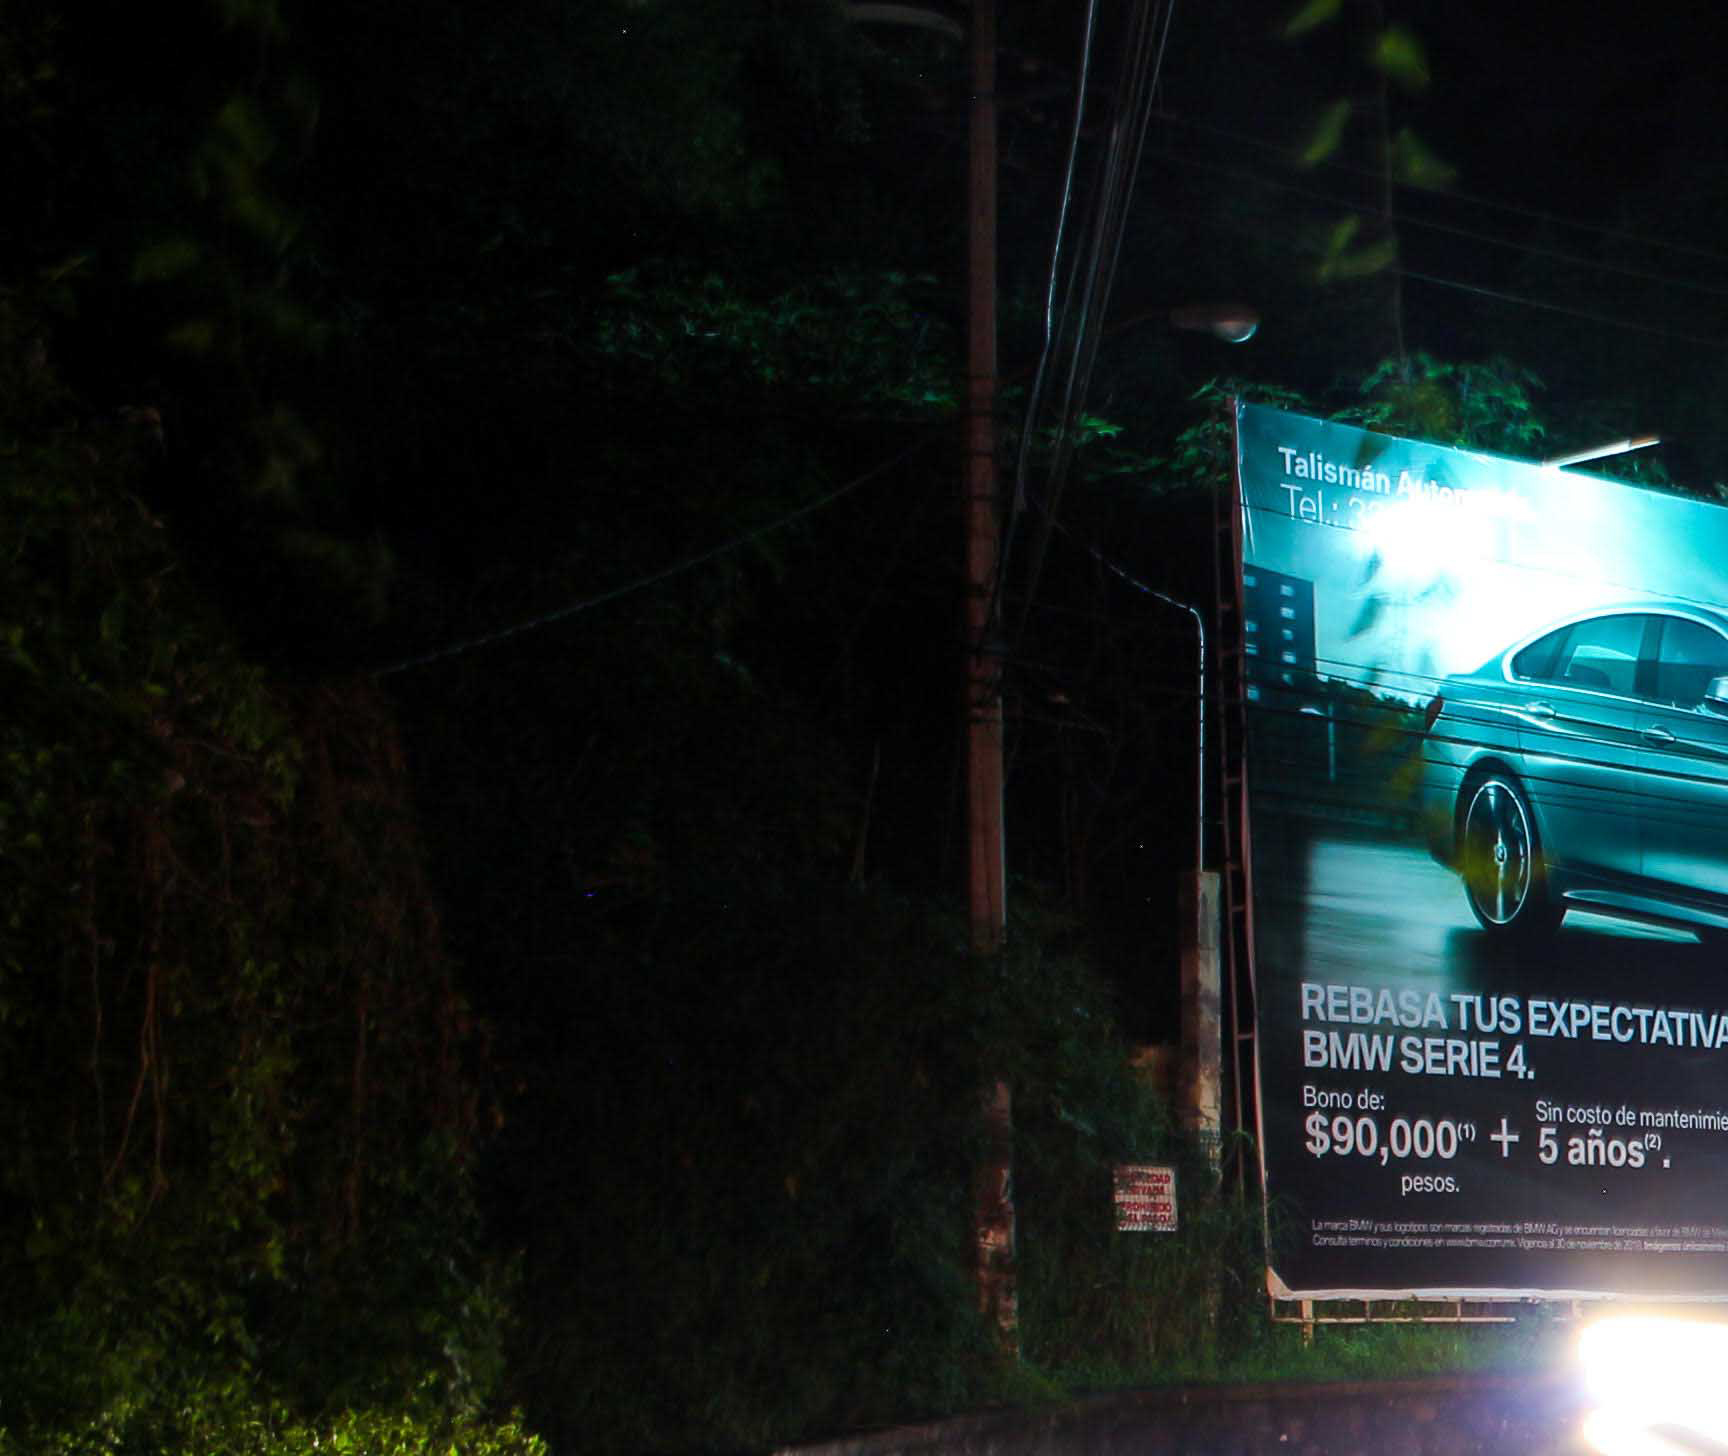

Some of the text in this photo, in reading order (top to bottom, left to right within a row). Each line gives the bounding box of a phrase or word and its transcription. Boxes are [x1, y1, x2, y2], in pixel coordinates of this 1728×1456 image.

[1278, 446, 1390, 496] Talismán
[1301, 983, 1449, 1030] REBASA
[1451, 993, 1521, 1035] TUS
[1303, 1030, 1535, 1080] BMW SERIE 4.
[1303, 1085, 1385, 1111] Bono de:
[1535, 1100, 1563, 1123] Sin
[1566, 1104, 1612, 1126] costo
[1615, 1105, 1636, 1127] de
[1490, 1118, 1520, 1159] +
[1538, 1127, 1560, 1165] 5
[1401, 1175, 1460, 1197] pesos.
